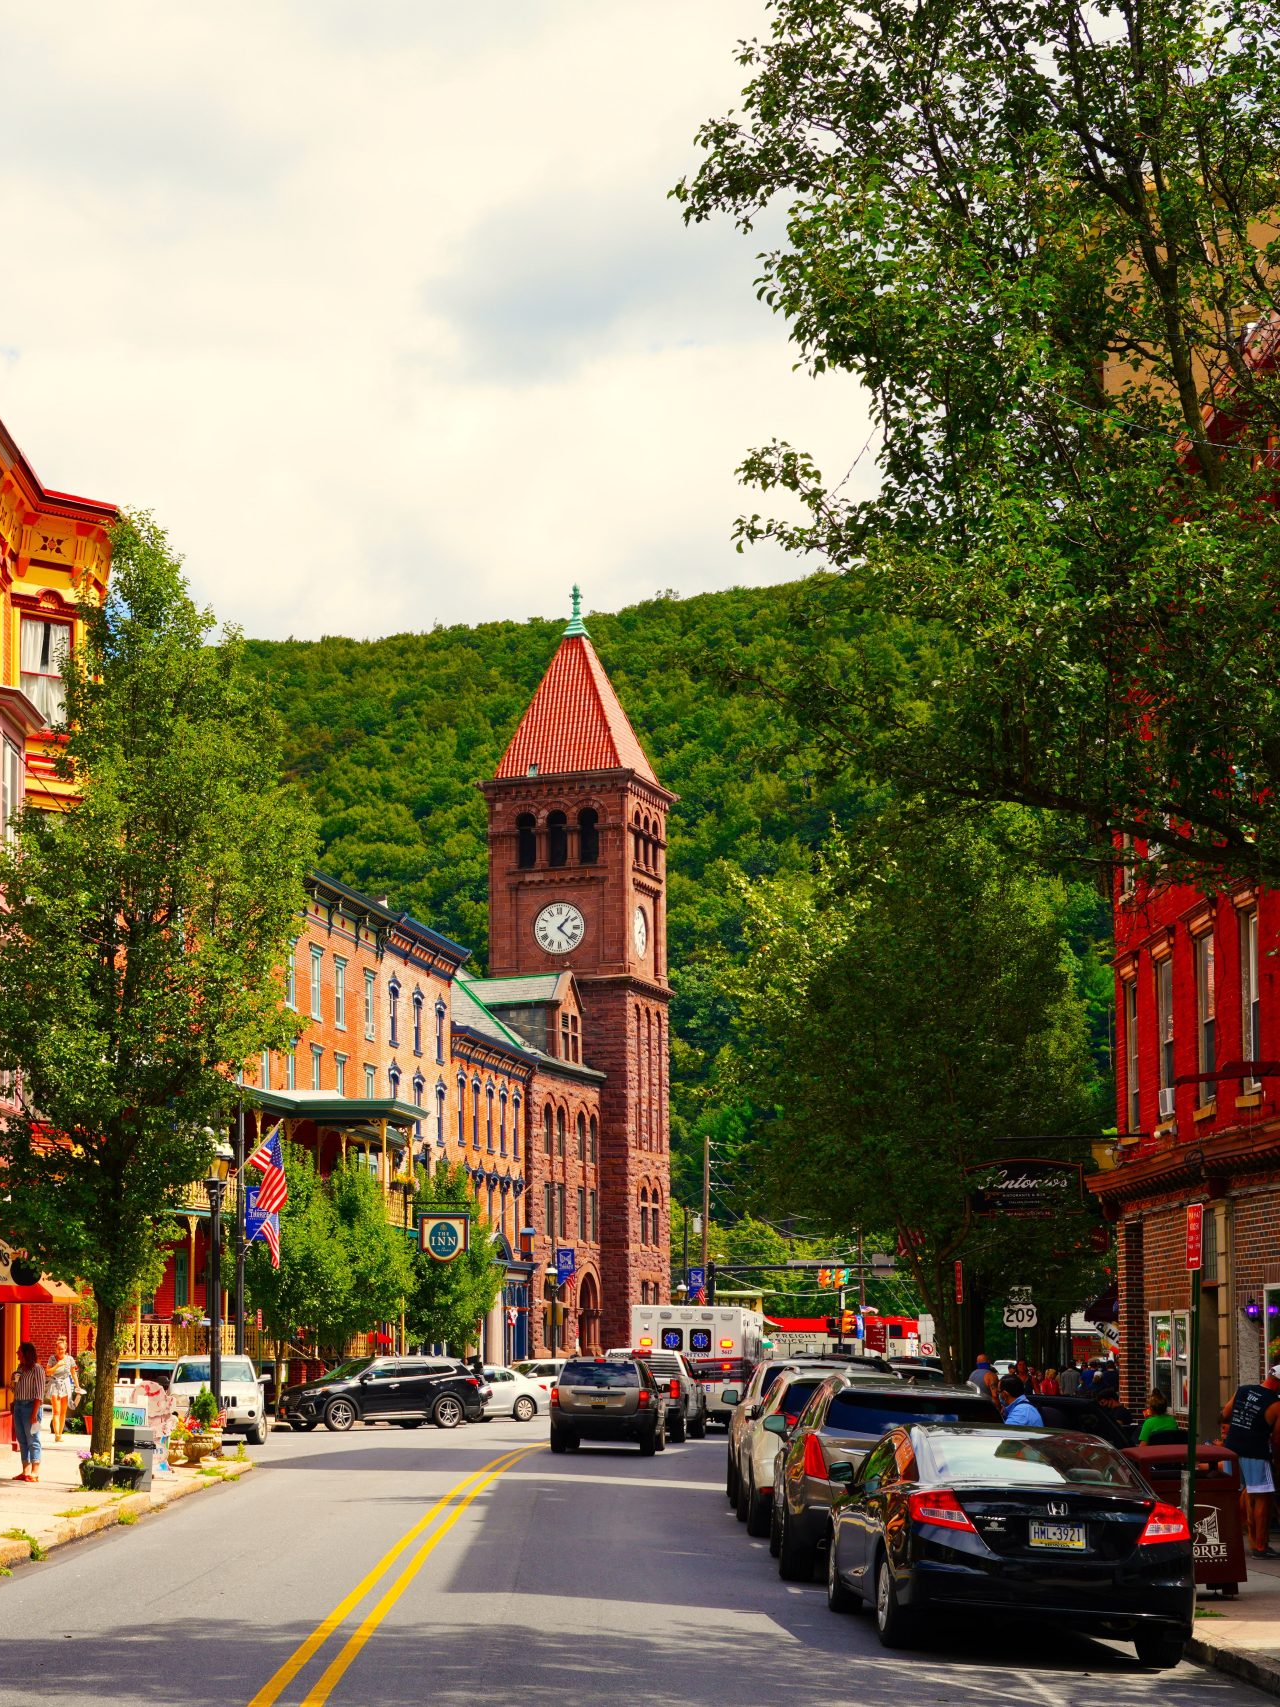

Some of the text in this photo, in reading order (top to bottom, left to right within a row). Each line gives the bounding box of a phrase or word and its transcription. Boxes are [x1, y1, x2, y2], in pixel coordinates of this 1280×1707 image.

[431, 1237, 456, 1246] INN
[1006, 1308, 1034, 1322] 209
[131, 1413, 143, 1425] END
[1193, 1545, 1227, 1558] ORPE
